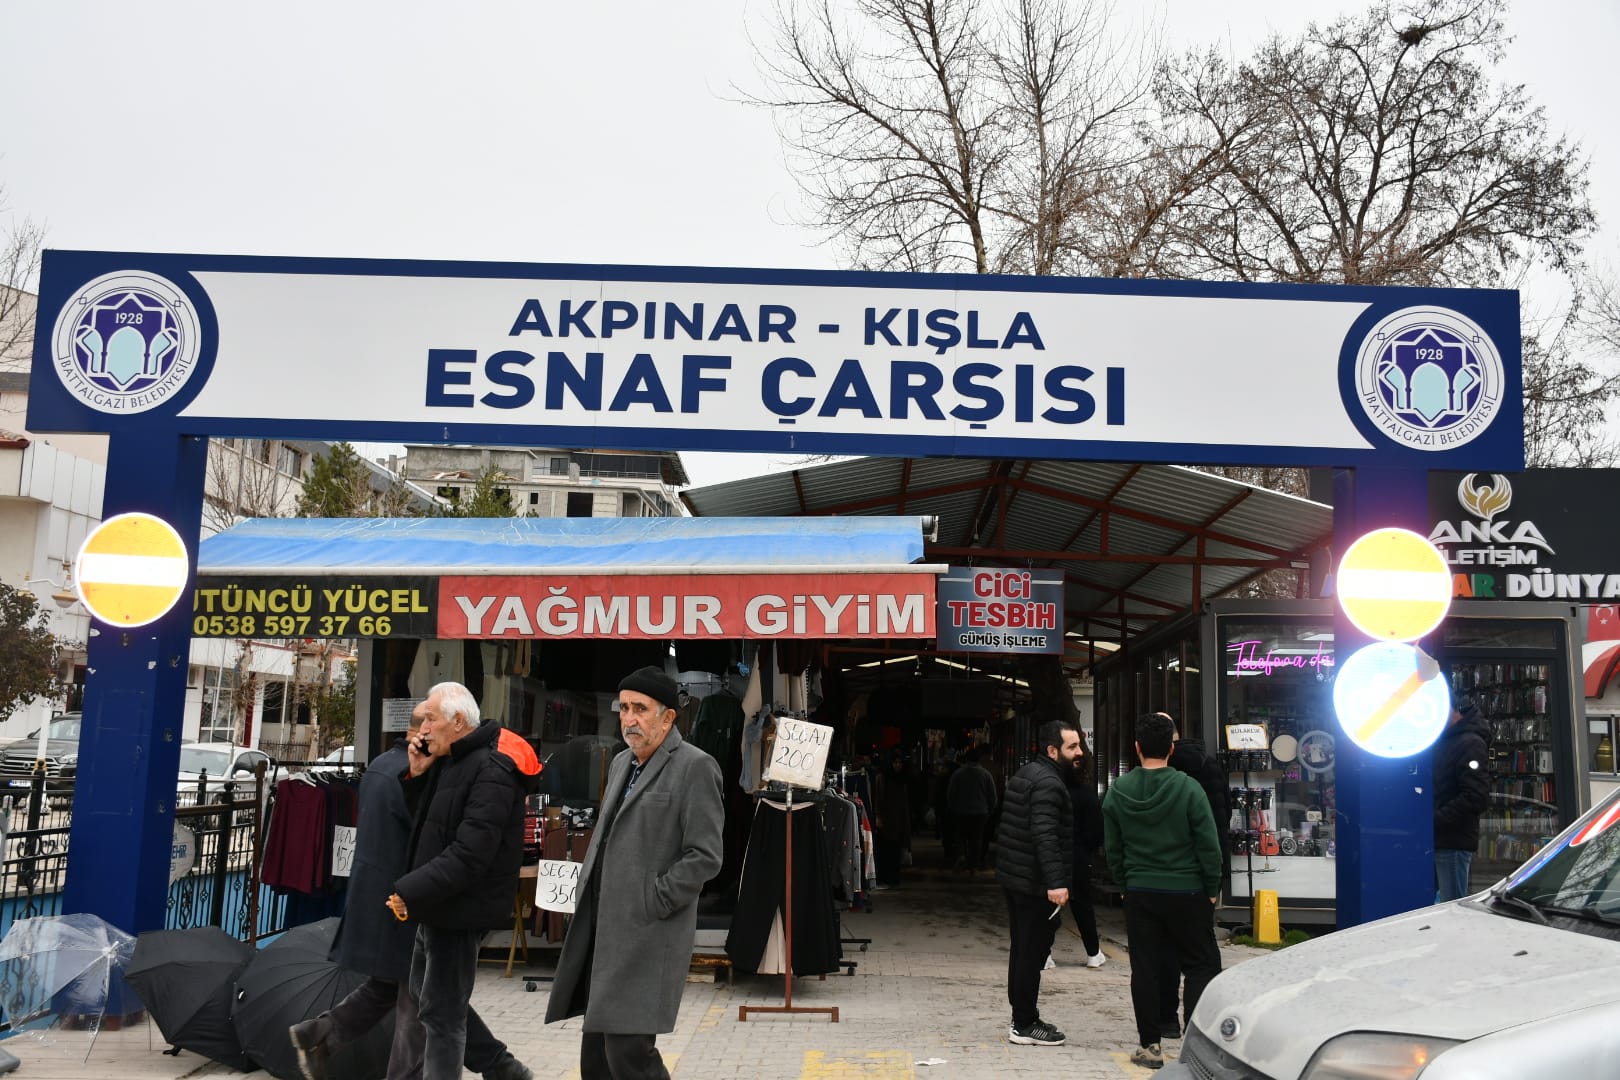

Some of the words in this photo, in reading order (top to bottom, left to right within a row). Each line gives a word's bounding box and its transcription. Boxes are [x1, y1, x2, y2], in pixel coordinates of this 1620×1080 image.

[115, 312, 144, 324] 1928
[507, 299, 797, 344] AKPINAR
[864, 307, 1046, 355] KIŞLA
[1415, 348, 1444, 361] 1928
[60, 360, 126, 409] BATTALGAZİ
[131, 362, 189, 408] BELEDİYESİ
[425, 348, 732, 413] ESNAF
[761, 357, 1125, 429] ÇARŞISI
[1366, 396, 1435, 445] BATTALGAZİ
[1440, 399, 1494, 445] BELEDİYESİ
[1428, 520, 1556, 555] ANKA
[322, 584, 429, 613] YÜCEL
[454, 586, 723, 636] YAĞMUR
[193, 616, 255, 636] 0538
[263, 616, 311, 636] 597
[319, 616, 350, 636] 37
[358, 616, 392, 636] 66
[960, 632, 1001, 648] GÜMÜŞ
[1003, 633, 1046, 649] İŞLEME
[775, 746, 815, 770] 200
